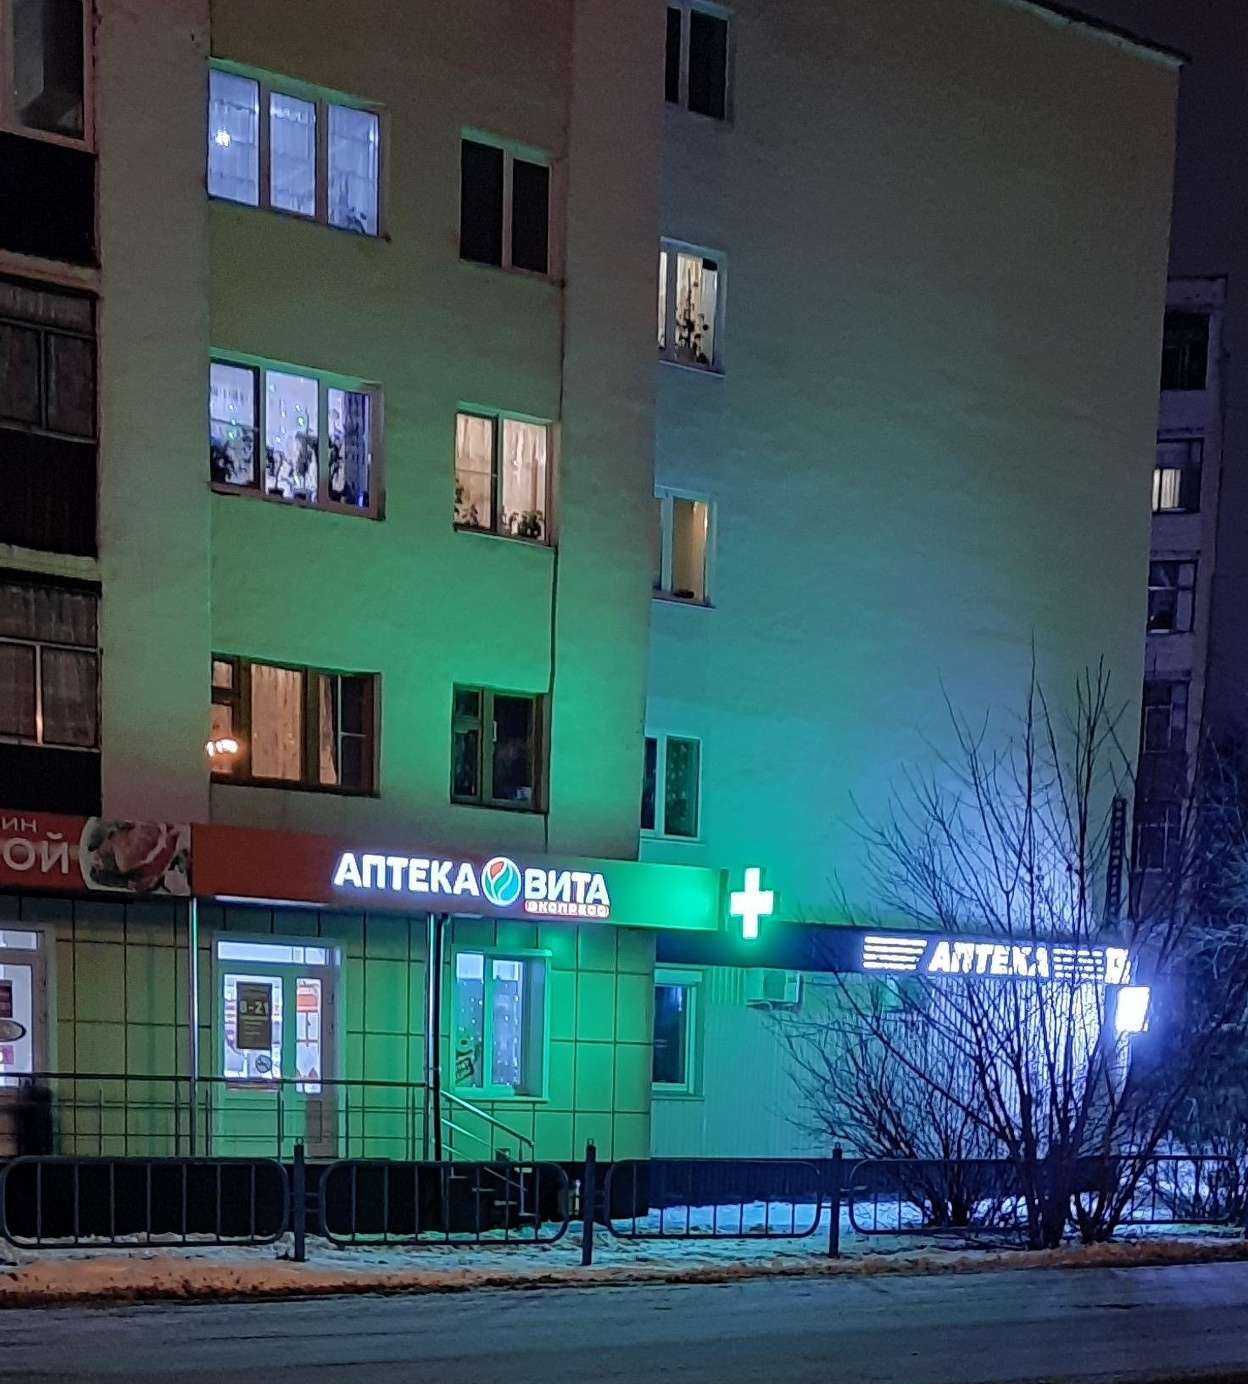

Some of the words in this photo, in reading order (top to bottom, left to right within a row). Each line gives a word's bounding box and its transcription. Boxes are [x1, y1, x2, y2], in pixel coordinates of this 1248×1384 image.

[3, 832, 69, 874] ОЙ
[334, 853, 480, 896] АПТЕКА
[524, 868, 610, 907] ВИТА
[928, 941, 1049, 977] АПТЕКА
